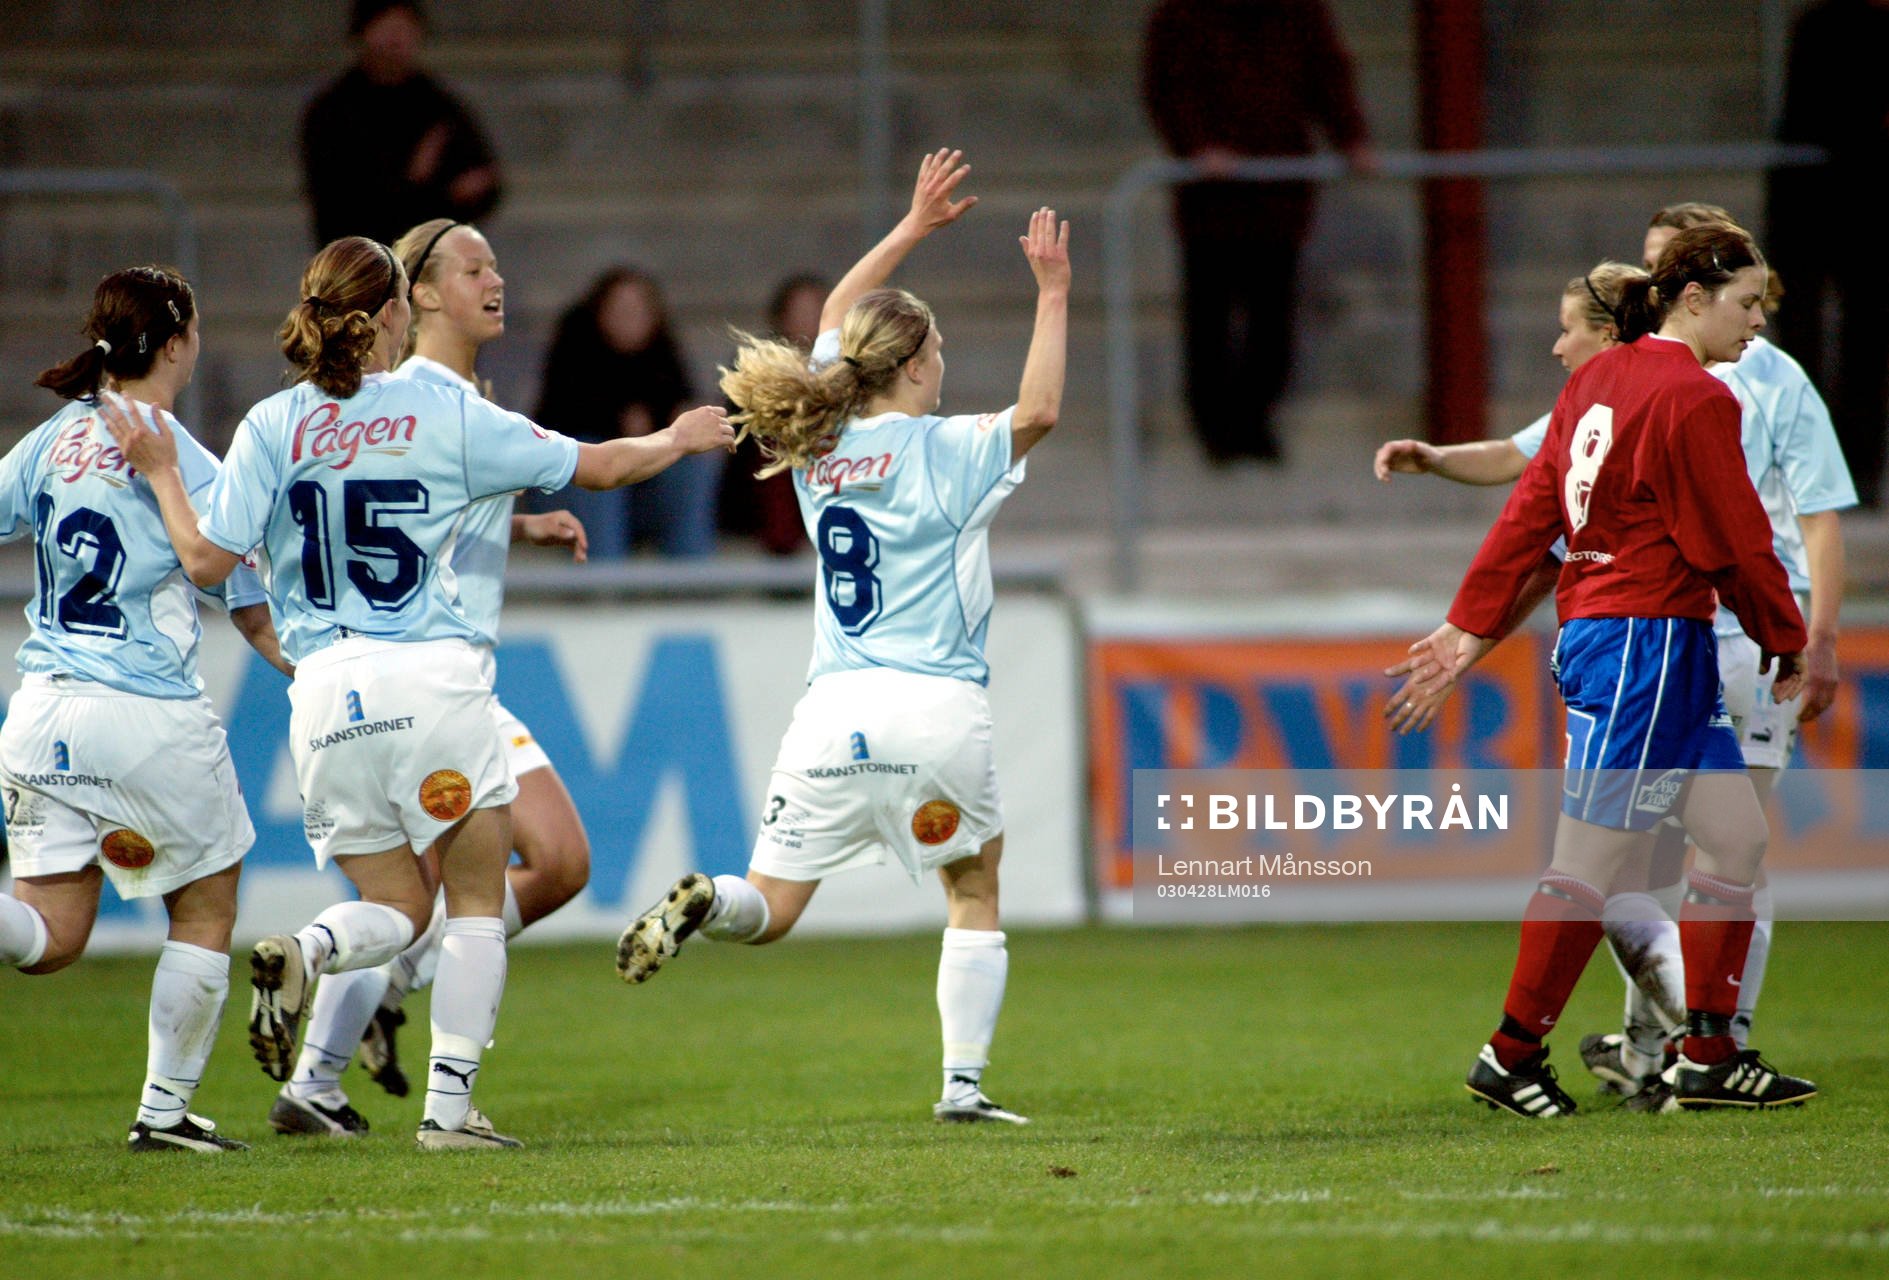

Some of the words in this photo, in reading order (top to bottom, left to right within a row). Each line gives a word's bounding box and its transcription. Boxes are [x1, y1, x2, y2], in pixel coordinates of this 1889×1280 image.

[291, 402, 417, 470] Pågen
[1564, 402, 1613, 535] 8
[34, 490, 127, 641] 12
[288, 479, 429, 612] 15
[817, 505, 882, 637] 8
[309, 716, 415, 752] SKANSTORNET
[806, 762, 919, 778] SKANSTORNET
[763, 795, 786, 826] 3
